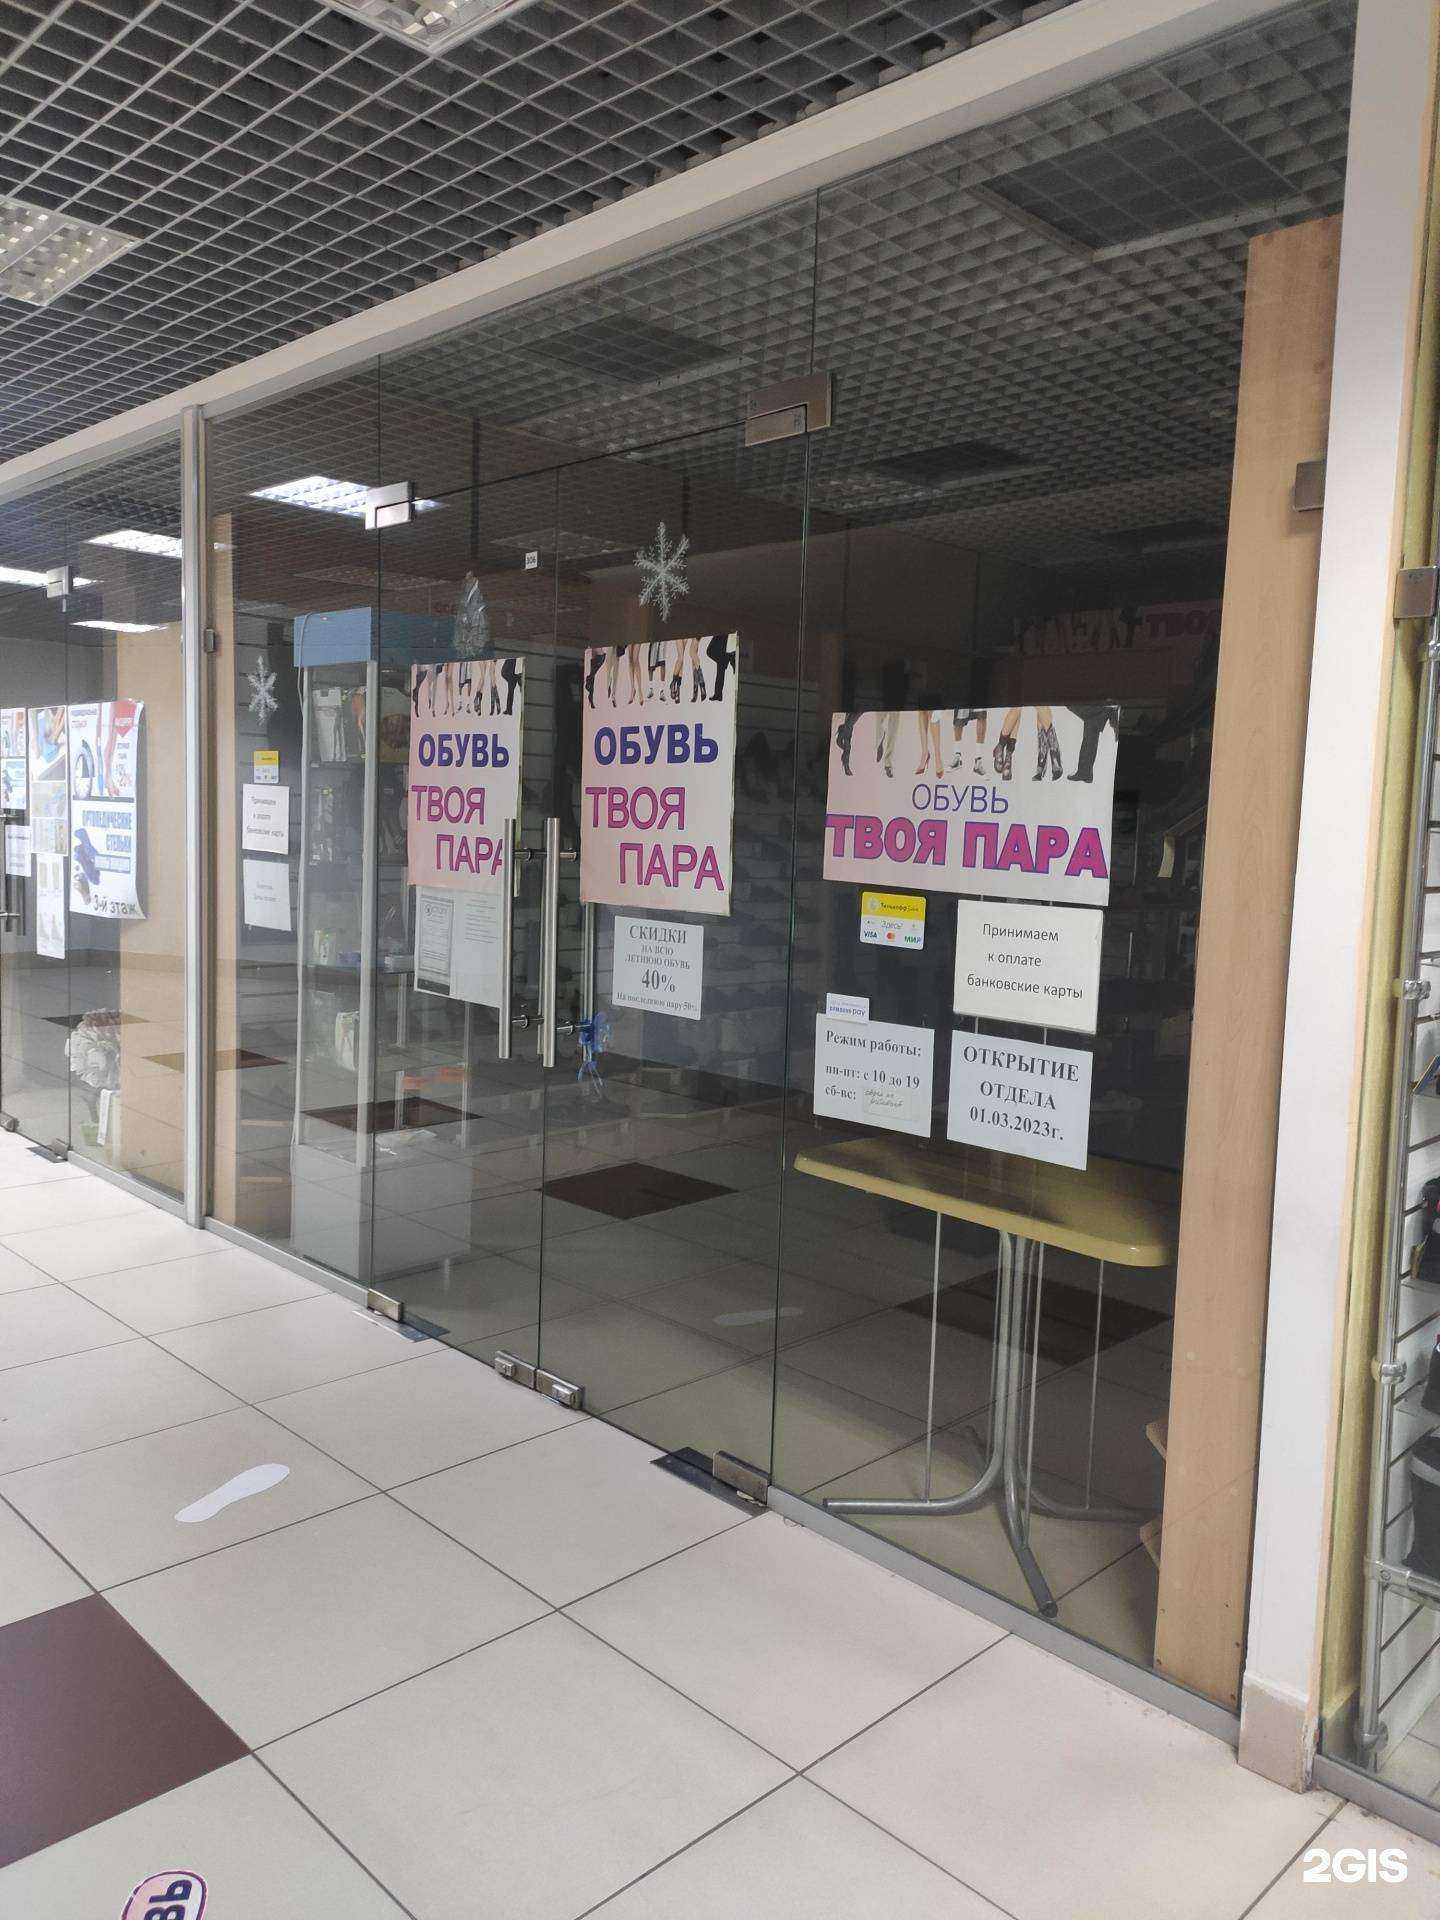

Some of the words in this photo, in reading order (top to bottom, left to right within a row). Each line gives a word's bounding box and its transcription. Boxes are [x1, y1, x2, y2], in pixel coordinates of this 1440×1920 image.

[418, 733, 510, 768] ОБУВЬ
[594, 723, 719, 766] ОБУВЬ
[412, 785, 486, 825] ТВОЯ
[585, 786, 686, 830] ТВОЯ
[912, 784, 1009, 814] ОБУВЬ
[825, 814, 948, 865] ТВОЯ
[962, 821, 1109, 879] ПАРА
[619, 843, 725, 891] ПАРА
[629, 924, 688, 944] СКИДКИ
[982, 923, 1060, 942] Принимаем
[641, 945, 653, 954] НА
[988, 952, 994, 962] к
[997, 953, 1042, 967] оплате
[664, 958, 690, 970] ОБУВЬ
[641, 968, 676, 993] 40%
[967, 973, 1040, 995] банковские
[1043, 985, 1084, 1000] карты
[826, 1030, 866, 1048] Режим
[870, 1039, 922, 1057] работы:
[826, 1065, 860, 1079] пн-пт:
[863, 1071, 869, 1080] с
[873, 1069, 886, 1083] 10
[889, 1076, 902, 1087] до
[906, 1074, 920, 1089] 19
[963, 1046, 1079, 1082] ОТКРЫТИЕ
[825, 1084, 856, 1100] сб-вс:
[980, 1080, 1056, 1110] ОТДЕЛА
[969, 1105, 1064, 1141] 01.03.2023г.
